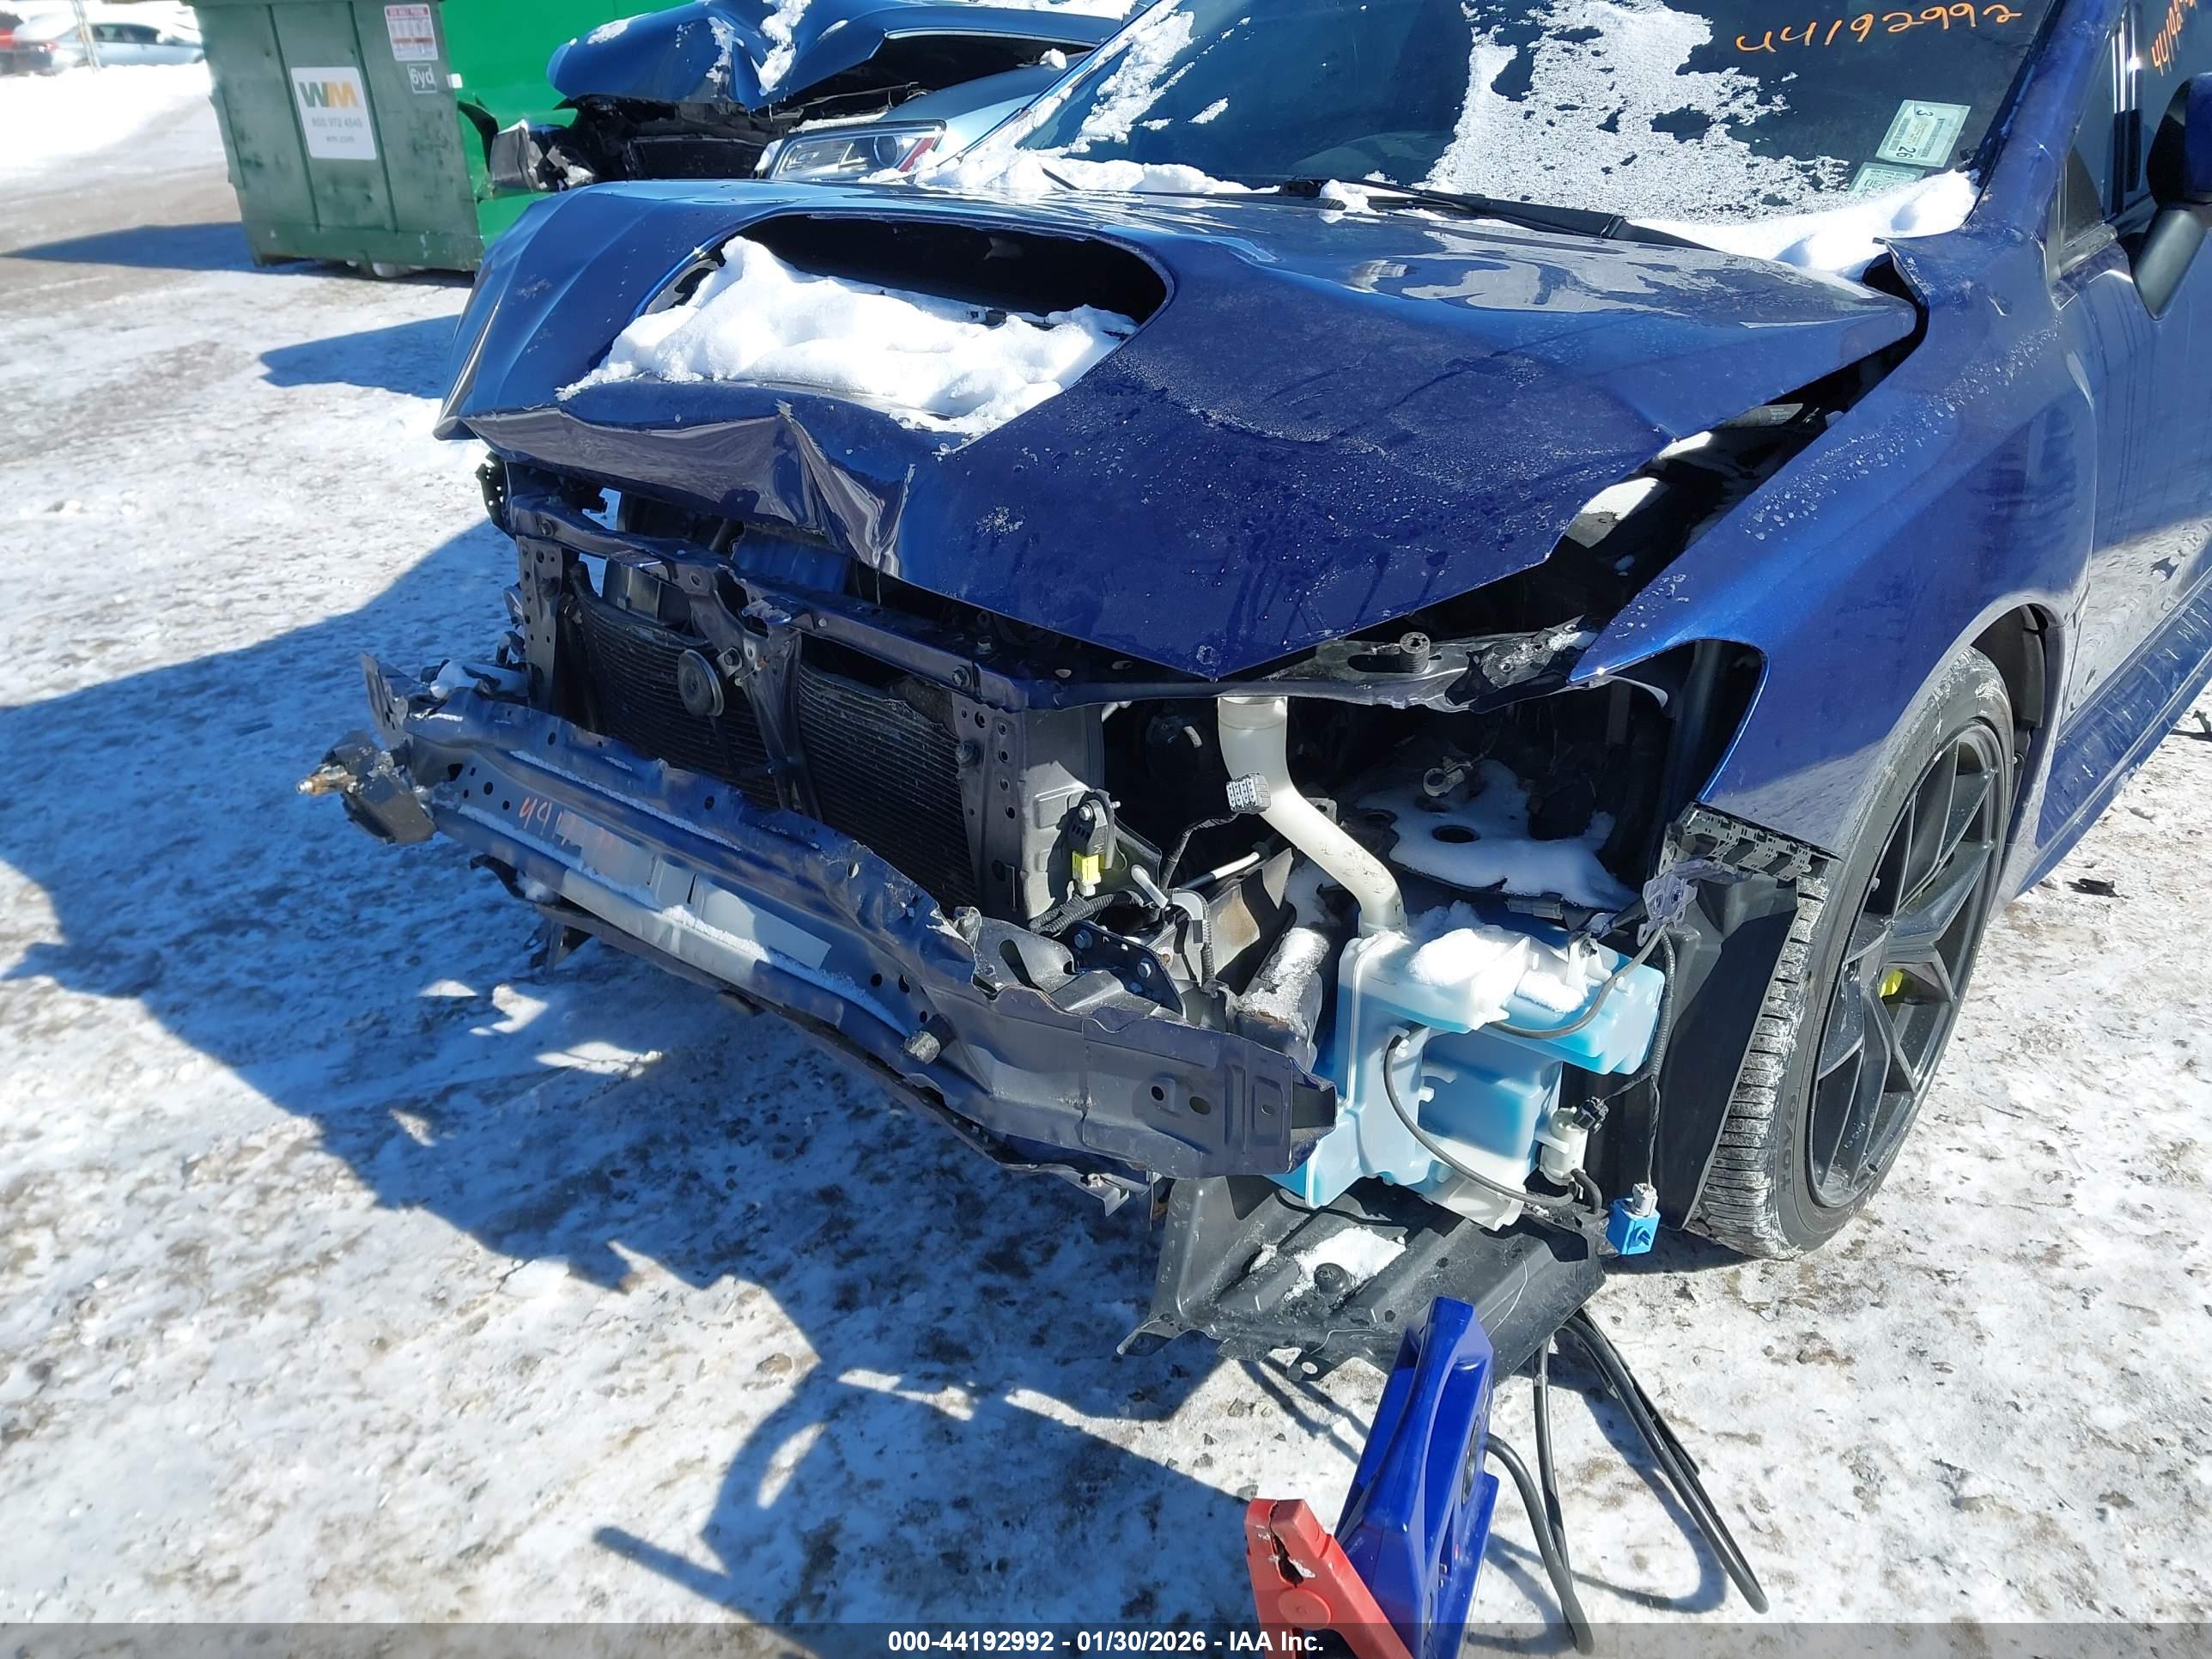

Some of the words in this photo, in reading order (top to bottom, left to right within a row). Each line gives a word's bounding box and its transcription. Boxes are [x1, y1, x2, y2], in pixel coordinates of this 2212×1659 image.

[1735, 3, 2022, 52] 44192992
[410, 68, 434, 88] 6yd
[298, 82, 359, 108] WM
[1896, 146, 1917, 158] 26
